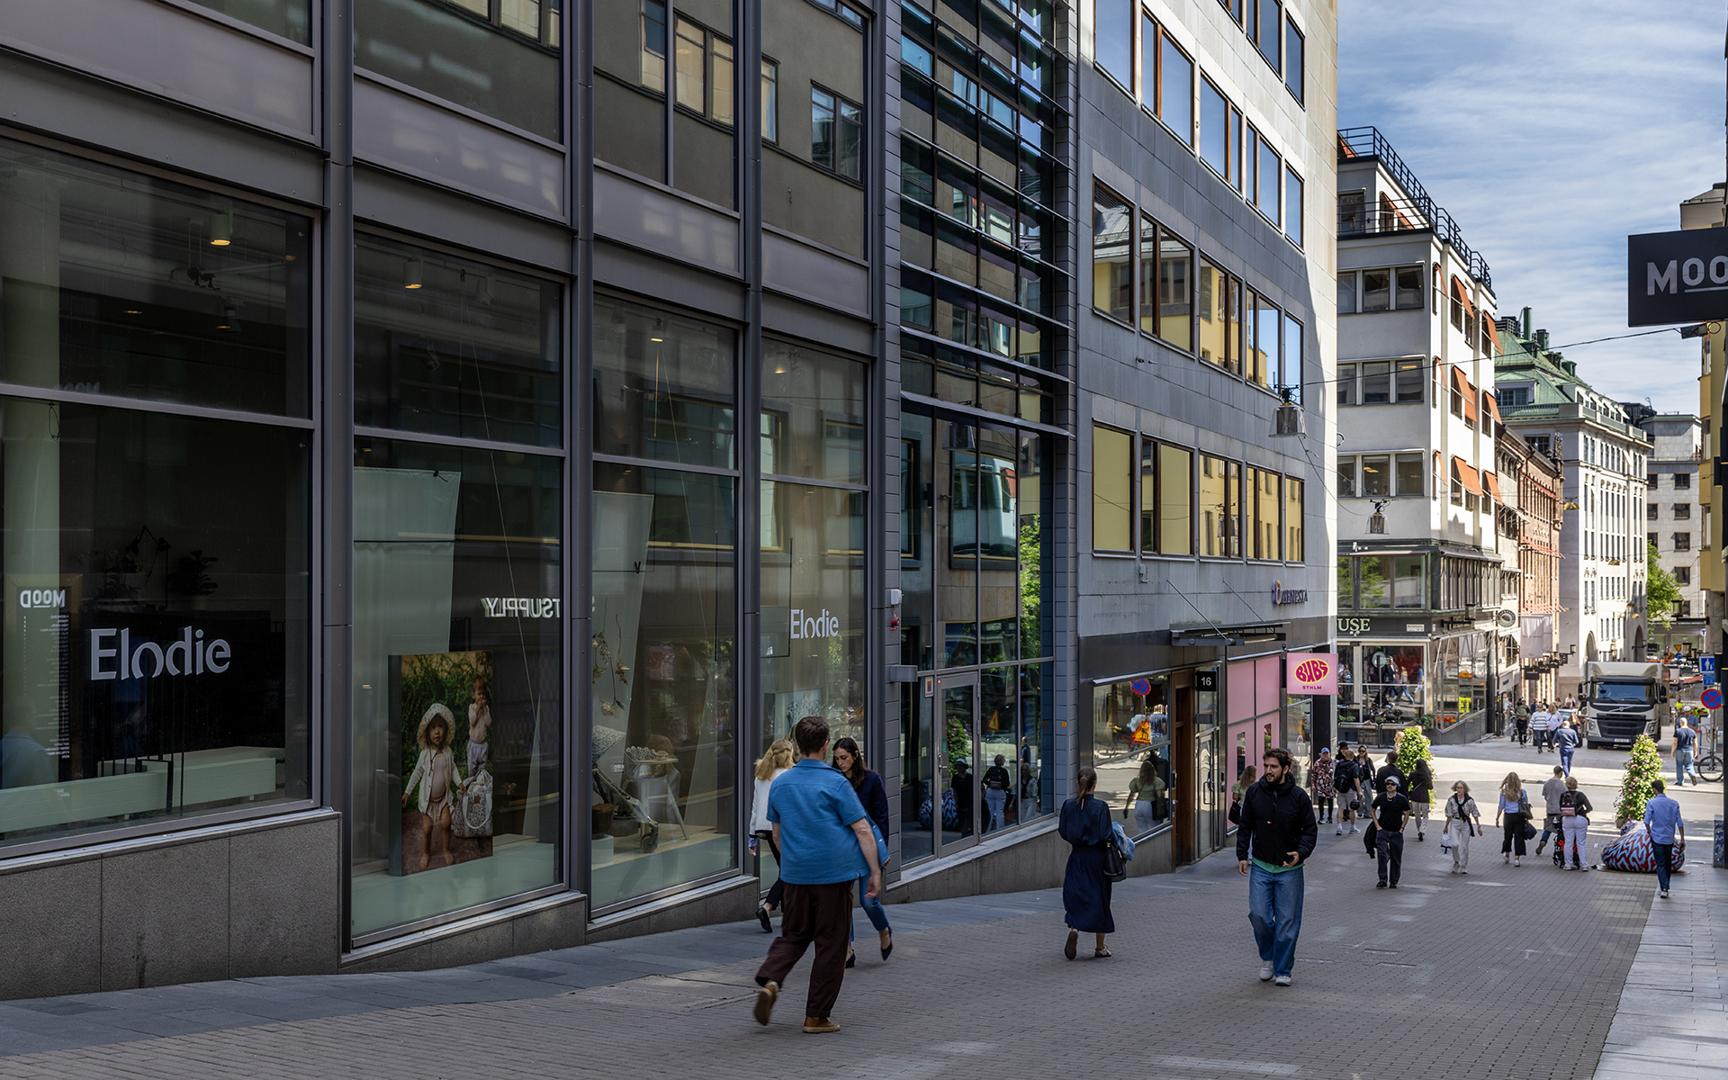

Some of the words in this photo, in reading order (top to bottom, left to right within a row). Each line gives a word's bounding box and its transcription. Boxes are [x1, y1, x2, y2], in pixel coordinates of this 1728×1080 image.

[1647, 255, 1728, 296] MOO
[790, 608, 839, 639] Elodie
[1337, 618, 1371, 632] USE
[90, 625, 232, 681] Elodie
[1200, 676, 1212, 686] 16
[1295, 659, 1328, 682] BUBS
